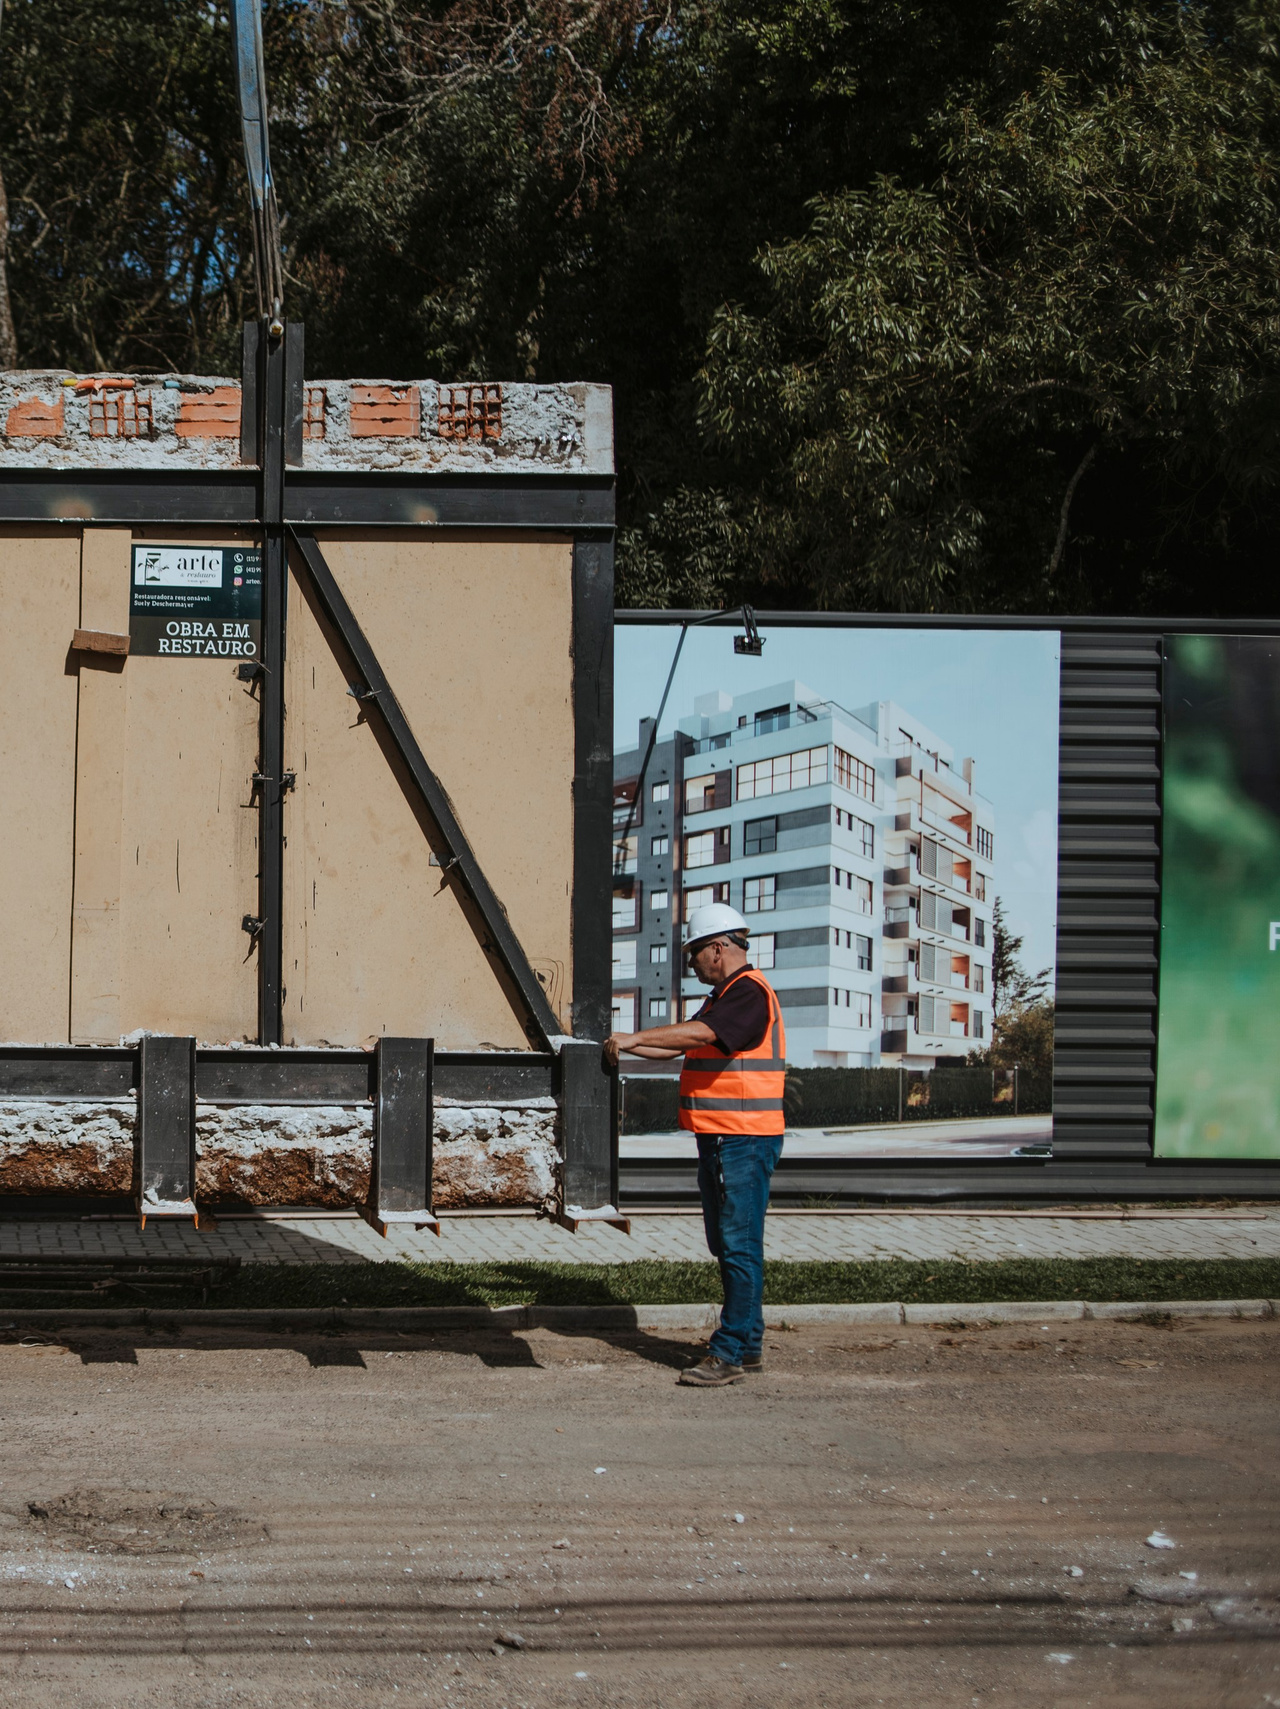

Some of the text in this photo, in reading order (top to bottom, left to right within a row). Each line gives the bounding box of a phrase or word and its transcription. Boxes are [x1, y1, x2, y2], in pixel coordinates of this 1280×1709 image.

[177, 555, 220, 571] arte
[134, 593, 173, 601] Restauradora
[166, 621, 250, 638] OBRA EM
[158, 638, 257, 656] RESTAURO
